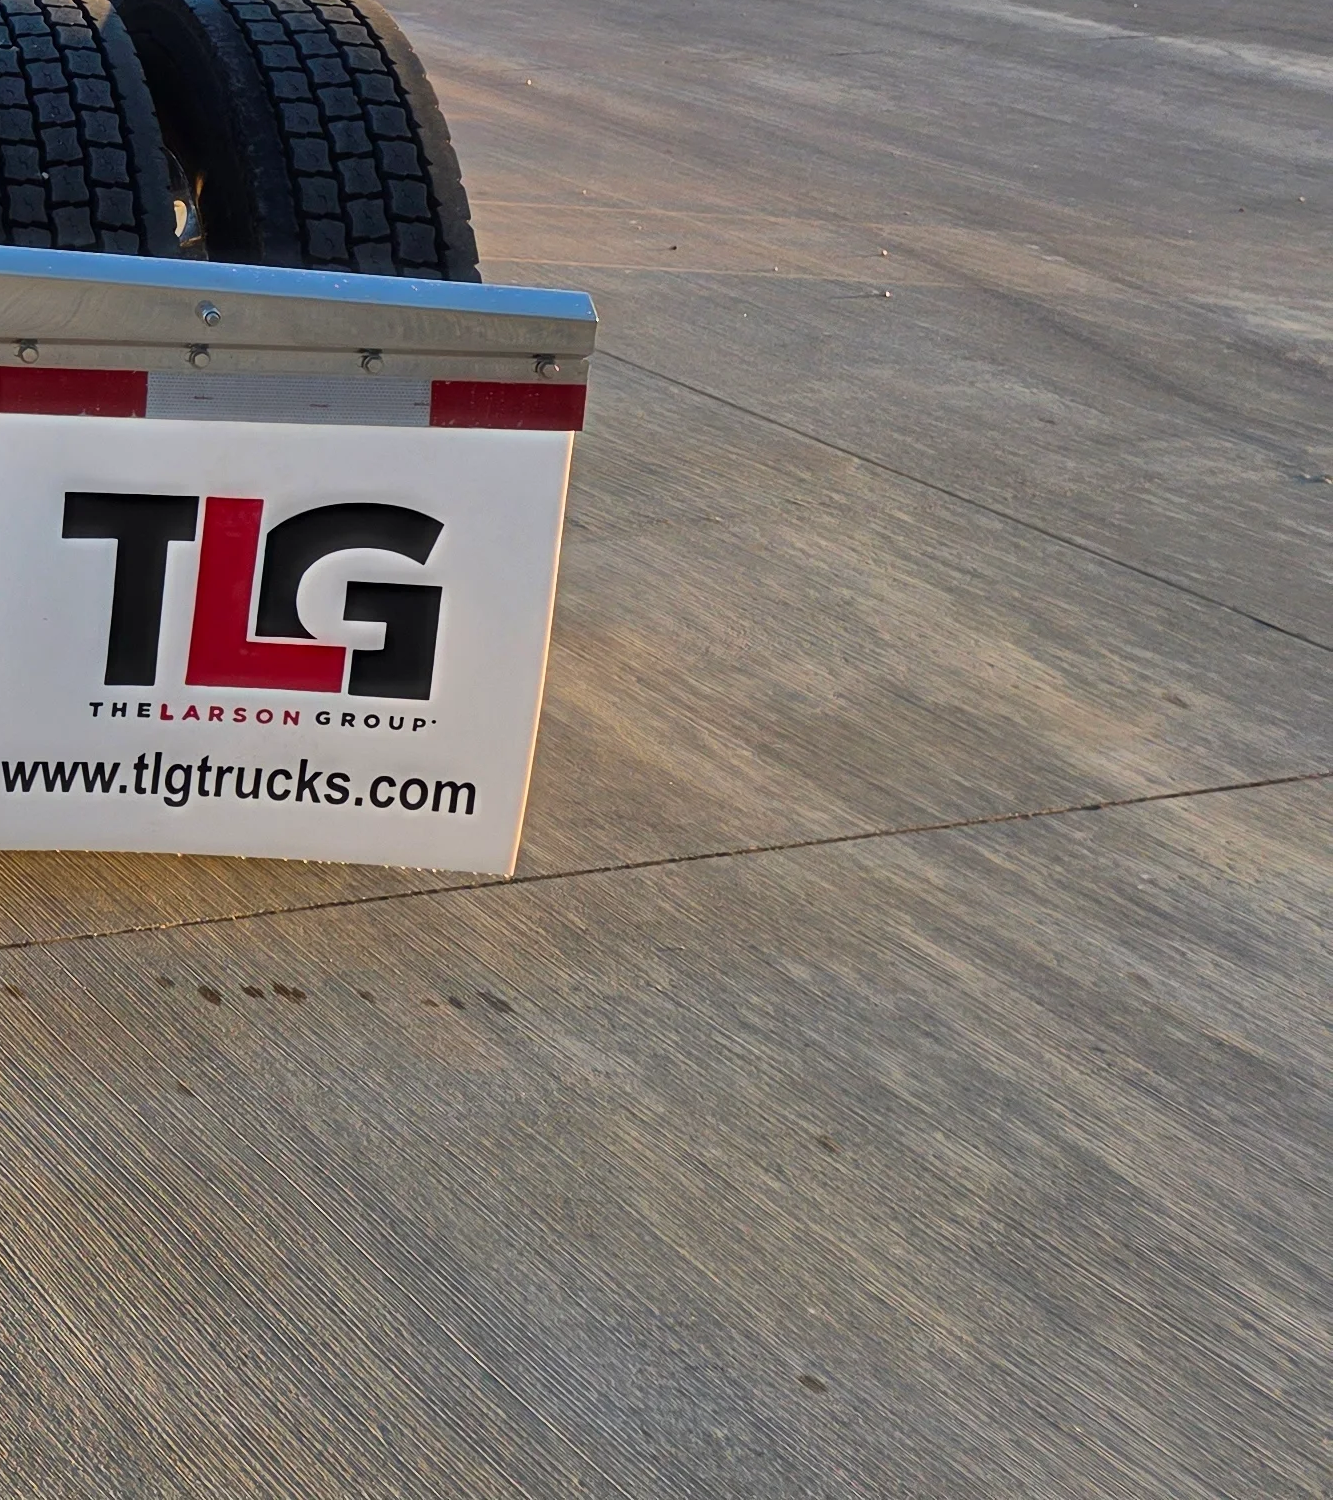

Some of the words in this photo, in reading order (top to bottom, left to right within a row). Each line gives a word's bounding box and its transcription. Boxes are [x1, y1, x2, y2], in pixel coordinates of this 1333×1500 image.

[61, 491, 445, 701] TLG
[315, 710, 428, 733] GROUP
[1, 750, 477, 817] www.tlgtrucks.com
